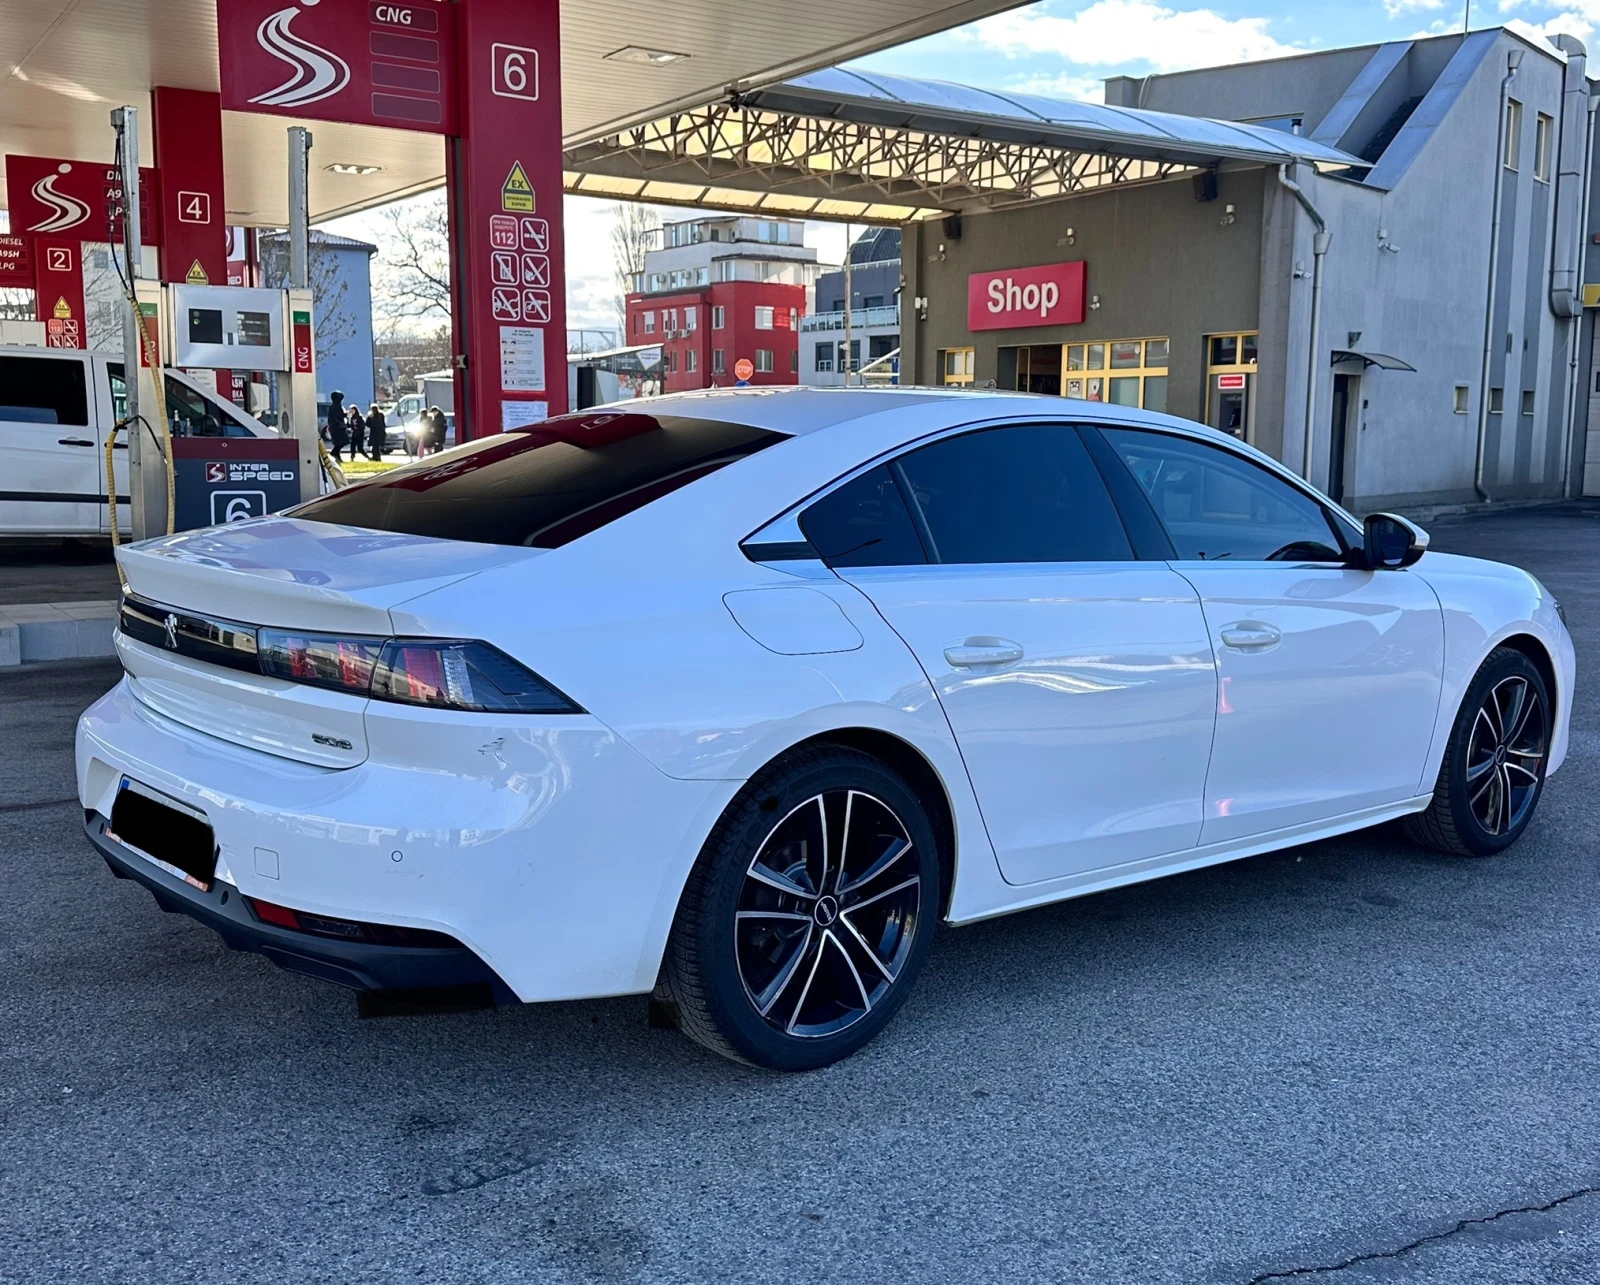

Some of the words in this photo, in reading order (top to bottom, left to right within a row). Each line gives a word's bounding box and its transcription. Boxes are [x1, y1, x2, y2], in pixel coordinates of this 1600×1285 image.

[375, 6, 412, 25] CNG
[503, 53, 527, 91] 6
[511, 180, 524, 189] EX
[186, 197, 202, 219] 4
[495, 231, 514, 244] 112
[53, 251, 66, 268] 2
[987, 278, 1059, 318] Shop
[297, 347, 309, 369] CNG
[229, 463, 269, 471] INTER
[229, 471, 294, 481] SPEED
[225, 497, 252, 522] 6
